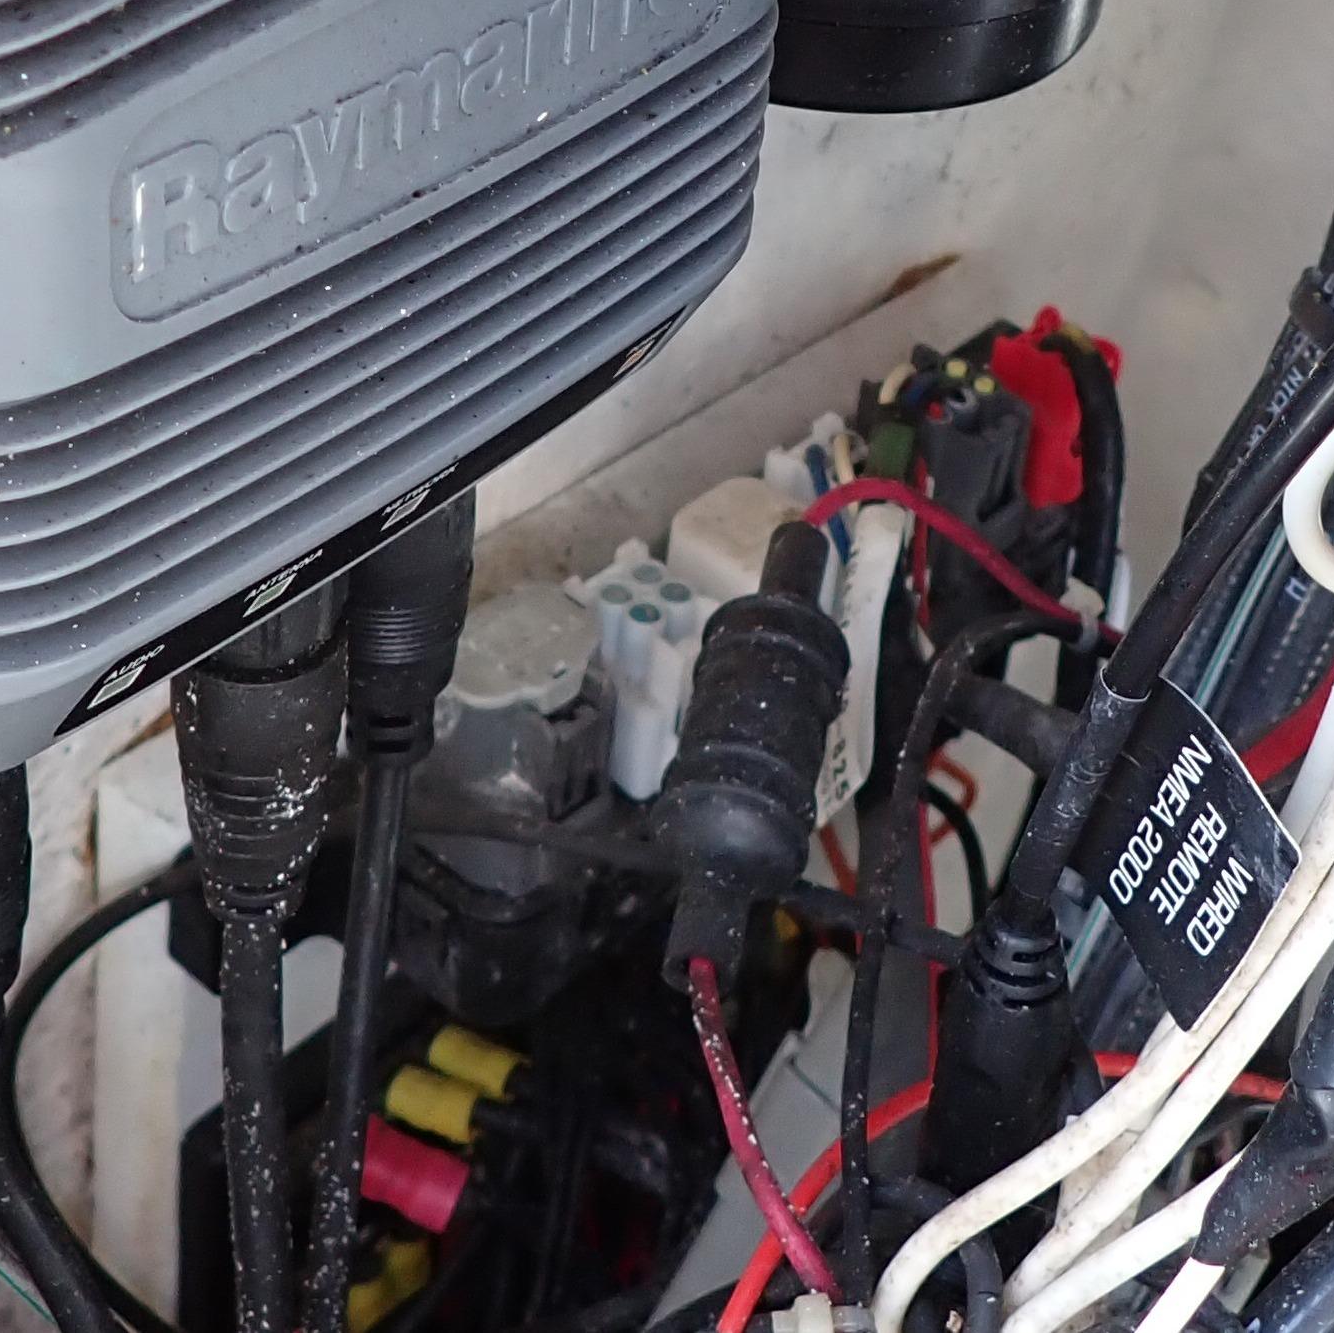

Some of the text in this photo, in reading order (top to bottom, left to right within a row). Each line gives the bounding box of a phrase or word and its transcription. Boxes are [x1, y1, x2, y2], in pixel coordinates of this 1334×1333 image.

[243, 548, 324, 603] ANTENNA
[102, 643, 166, 685] AUDIO
[1108, 734, 1214, 905] NMEA 2000
[1148, 801, 1228, 925] REMOTE
[1186, 855, 1254, 957] WIRED
